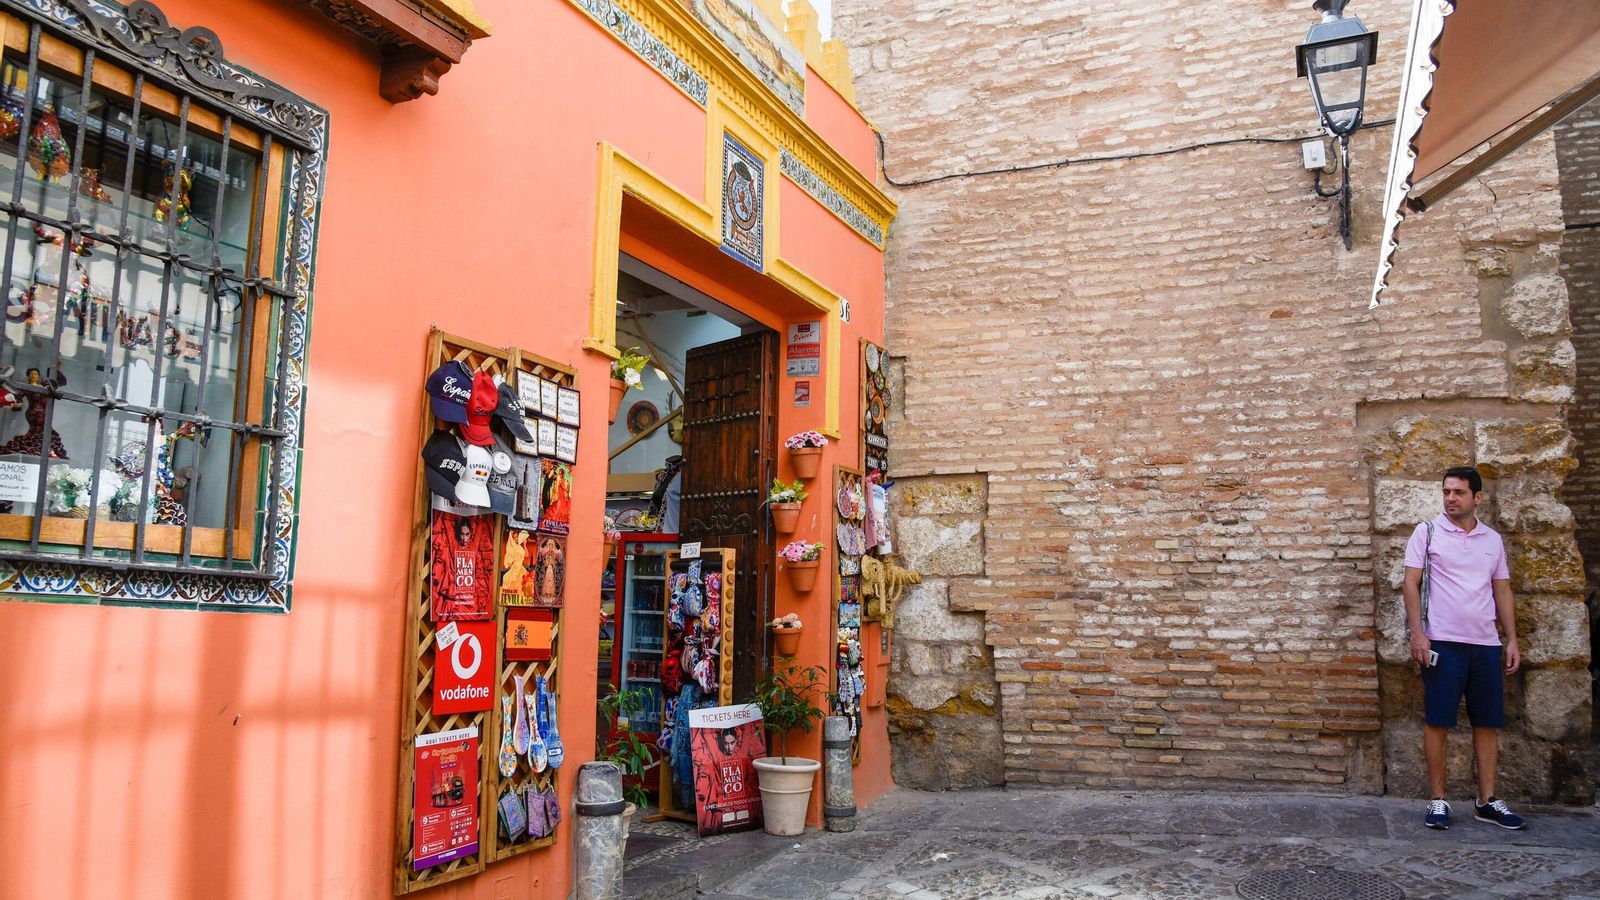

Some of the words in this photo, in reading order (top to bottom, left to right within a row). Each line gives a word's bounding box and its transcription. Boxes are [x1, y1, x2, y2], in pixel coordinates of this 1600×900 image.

[456, 557, 474, 568] FLA
[456, 575, 474, 587] CO
[440, 684, 490, 701] vodafone
[702, 712, 732, 723] TICKETS
[733, 709, 751, 720] HERE
[722, 766, 742, 777] FLA
[723, 774, 742, 784] MEN
[724, 781, 743, 794] CO
